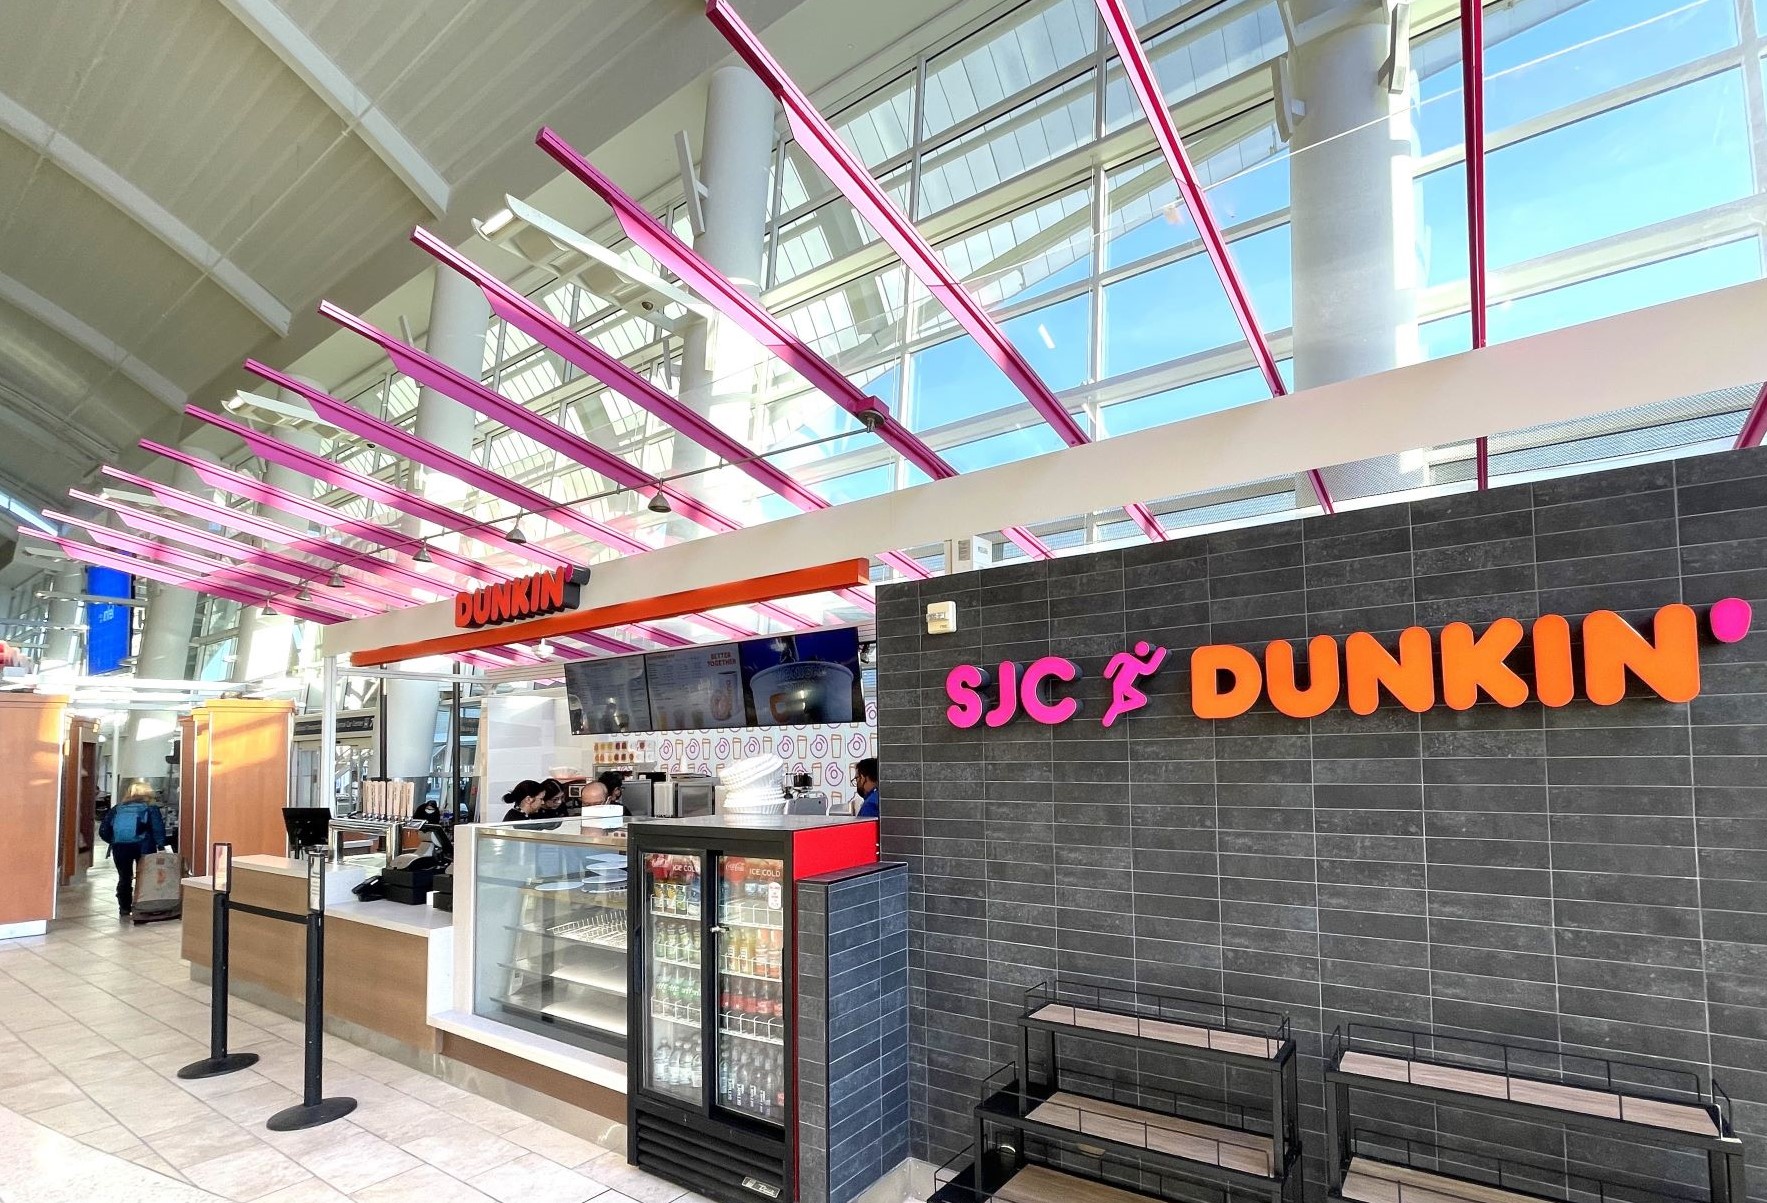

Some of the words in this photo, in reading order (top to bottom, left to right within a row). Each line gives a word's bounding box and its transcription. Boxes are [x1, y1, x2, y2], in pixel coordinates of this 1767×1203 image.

[455, 564, 574, 627] DUNKIN'
[710, 651, 731, 659] BETTER
[707, 658, 737, 667] TOGETHER
[946, 656, 1081, 728] SJC
[1191, 597, 1752, 719] DUNKIN'
[749, 868, 761, 876] ICE
[761, 868, 781, 878] COLD
